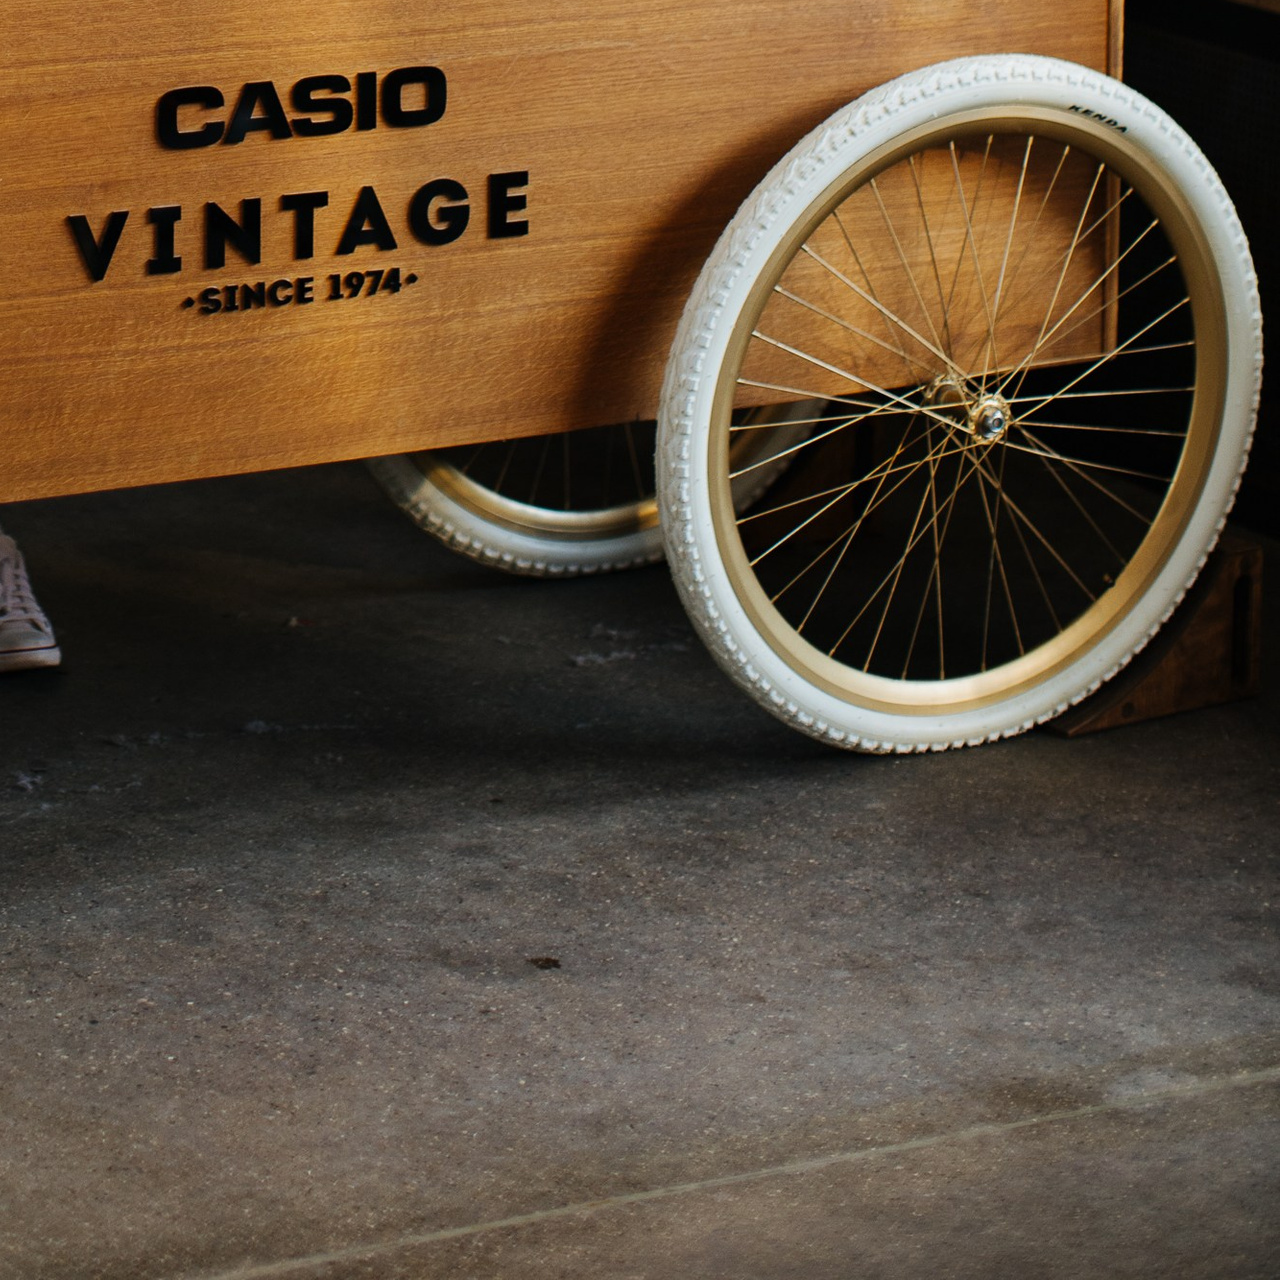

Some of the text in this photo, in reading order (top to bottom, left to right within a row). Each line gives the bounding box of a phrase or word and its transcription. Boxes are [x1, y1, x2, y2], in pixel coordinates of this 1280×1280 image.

[155, 66, 448, 150] CASIO
[1068, 104, 1128, 133] KENDA
[65, 170, 529, 282] VINTAGE
[198, 268, 403, 315] SINCE 1974
